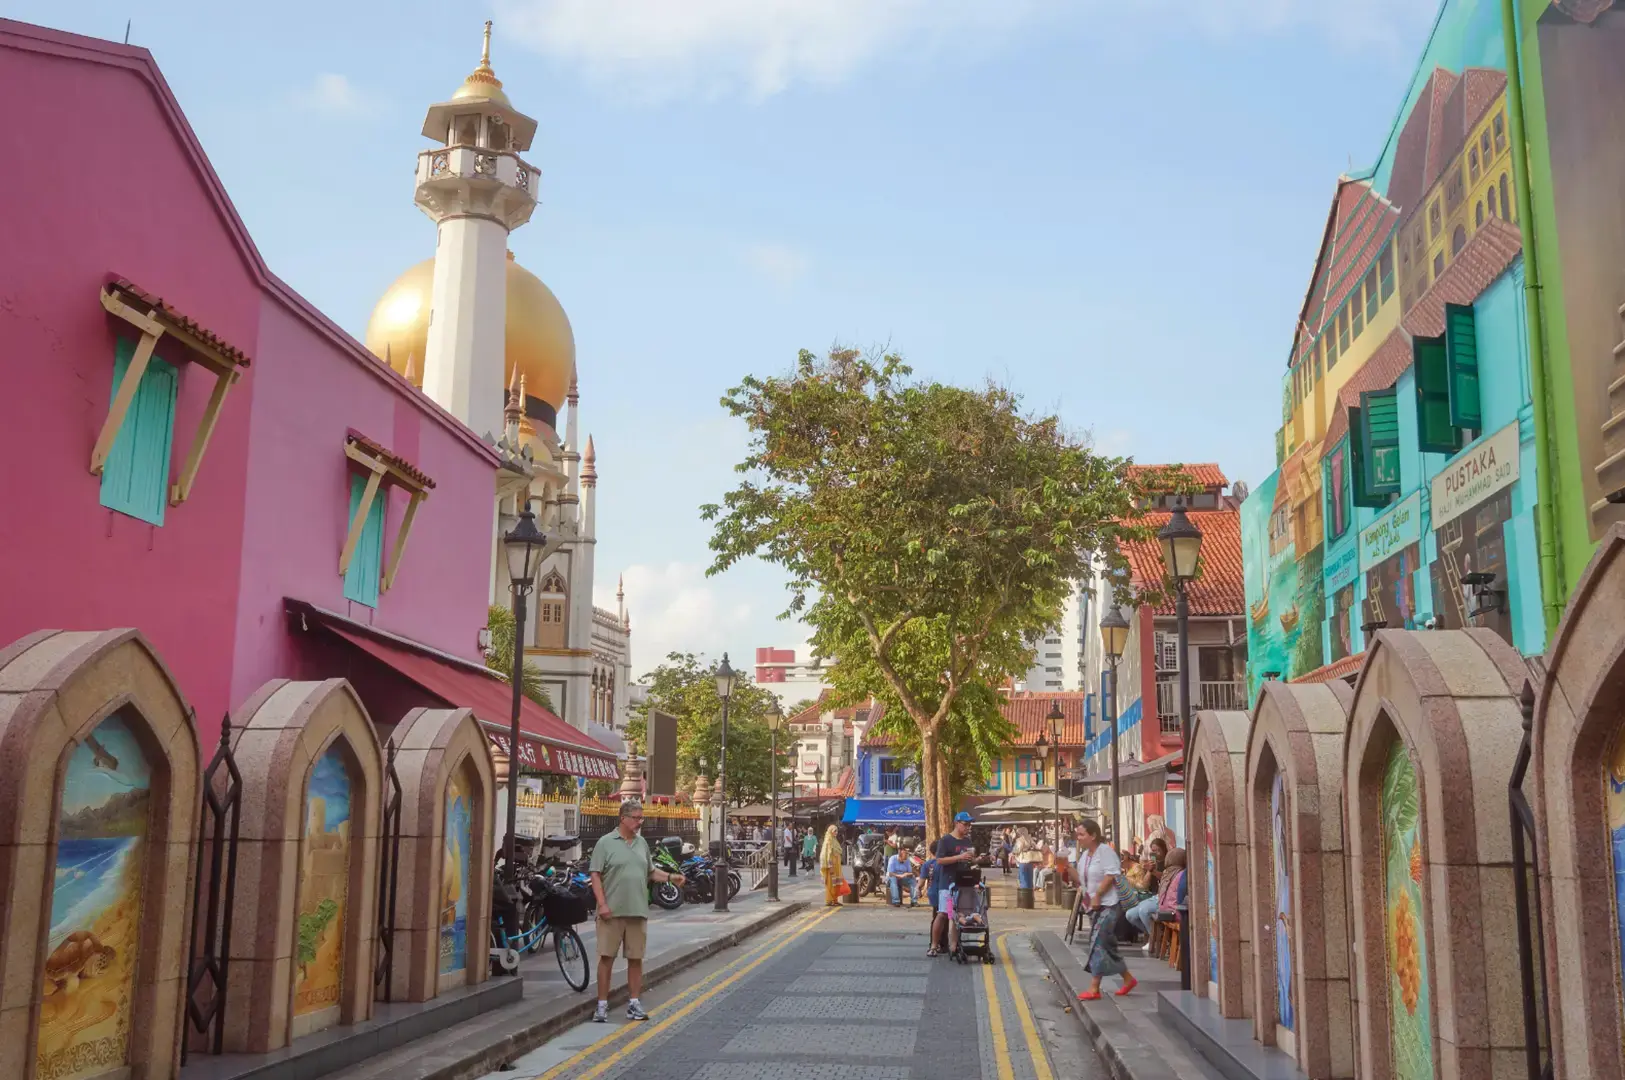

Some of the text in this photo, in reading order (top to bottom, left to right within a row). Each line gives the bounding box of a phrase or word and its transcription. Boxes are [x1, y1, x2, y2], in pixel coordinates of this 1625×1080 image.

[1439, 462, 1511, 517] HAJI MUHAMMAD SAID
[1445, 446, 1496, 497] PUSTAKA
